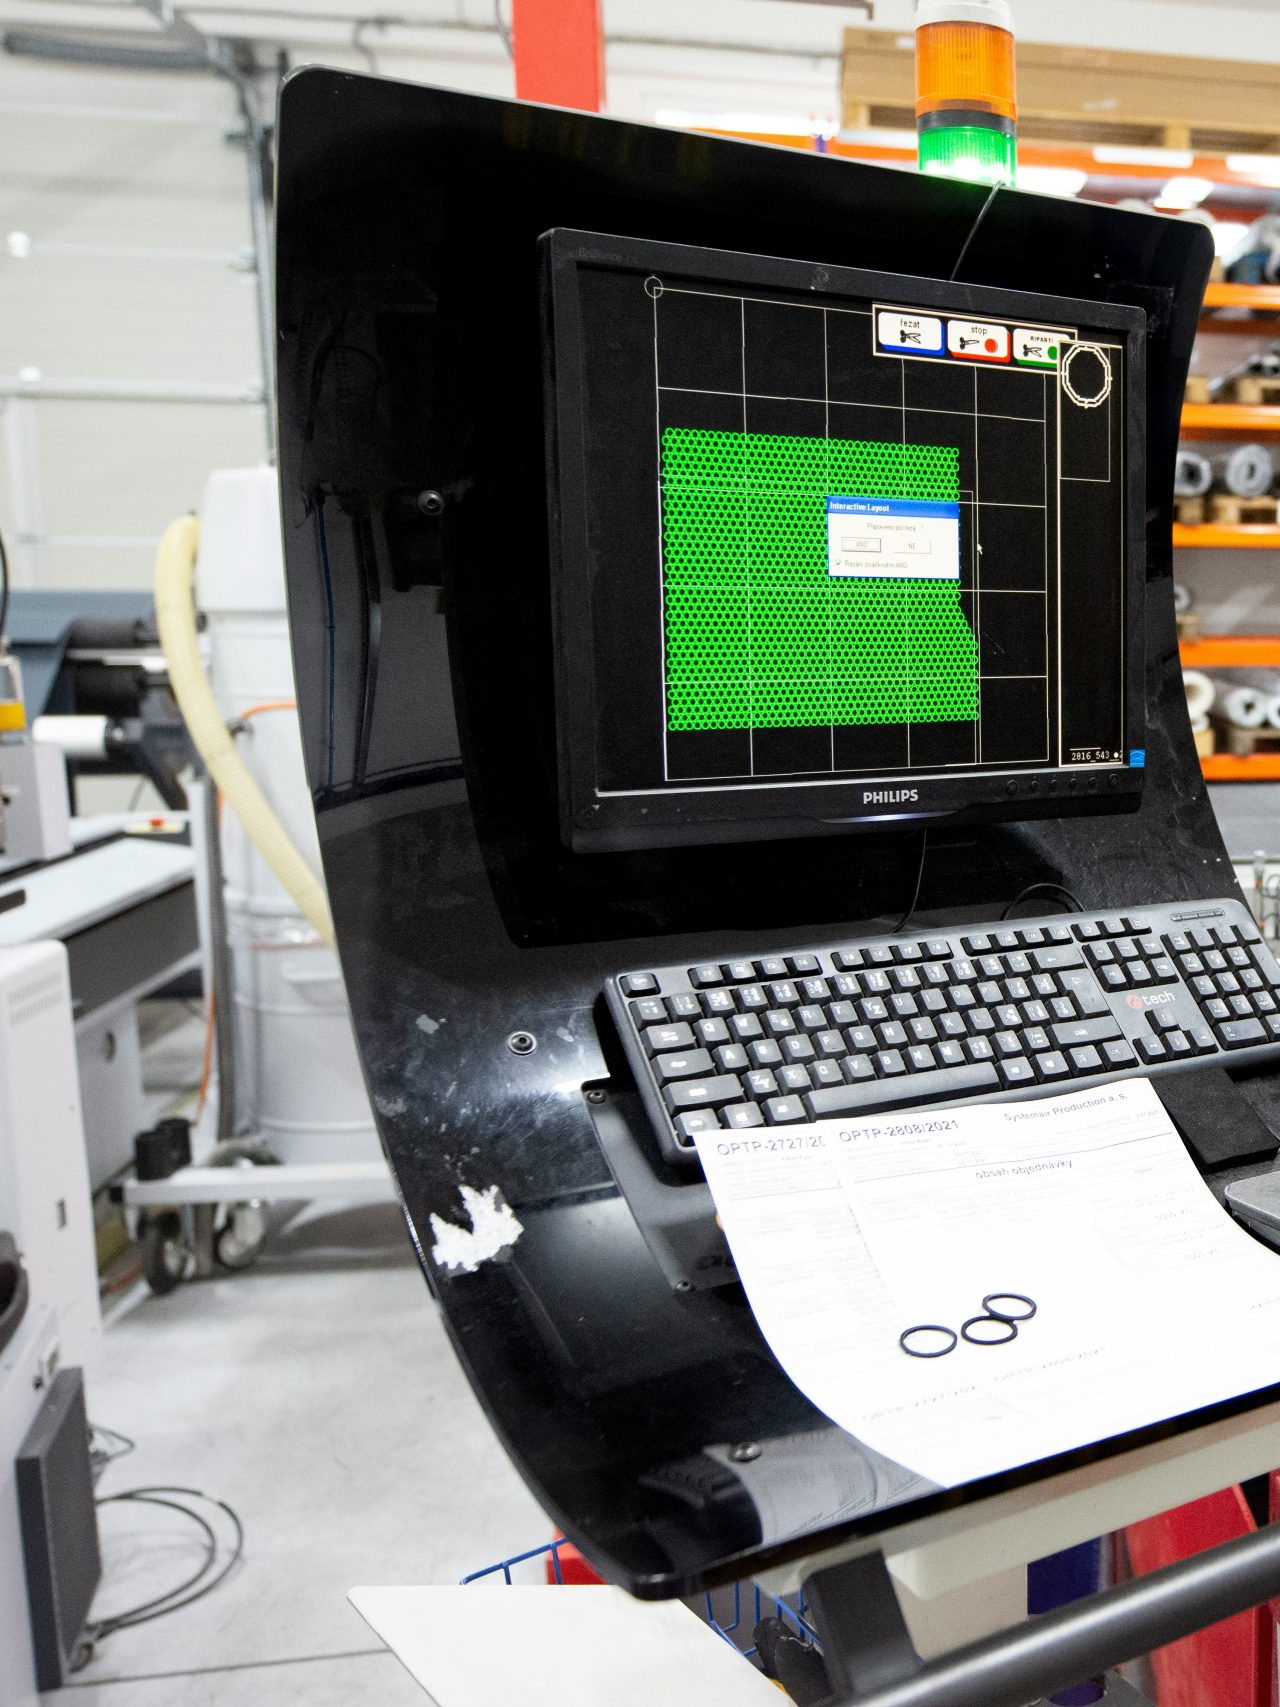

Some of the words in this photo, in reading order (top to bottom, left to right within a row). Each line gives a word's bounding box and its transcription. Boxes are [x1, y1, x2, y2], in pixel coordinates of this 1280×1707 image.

[970, 326, 988, 336] stop
[829, 502, 866, 512] Interactive
[867, 504, 890, 513] Layout
[863, 789, 919, 804] PHILIPS
[1142, 990, 1176, 1006] tech
[1003, 1109, 1051, 1122] Systemair
[1053, 1096, 1107, 1116] Production
[839, 1119, 960, 1143] OPTP-2808/2021
[975, 1166, 1010, 1180] obsah
[1011, 1159, 1073, 1177] objednávky
